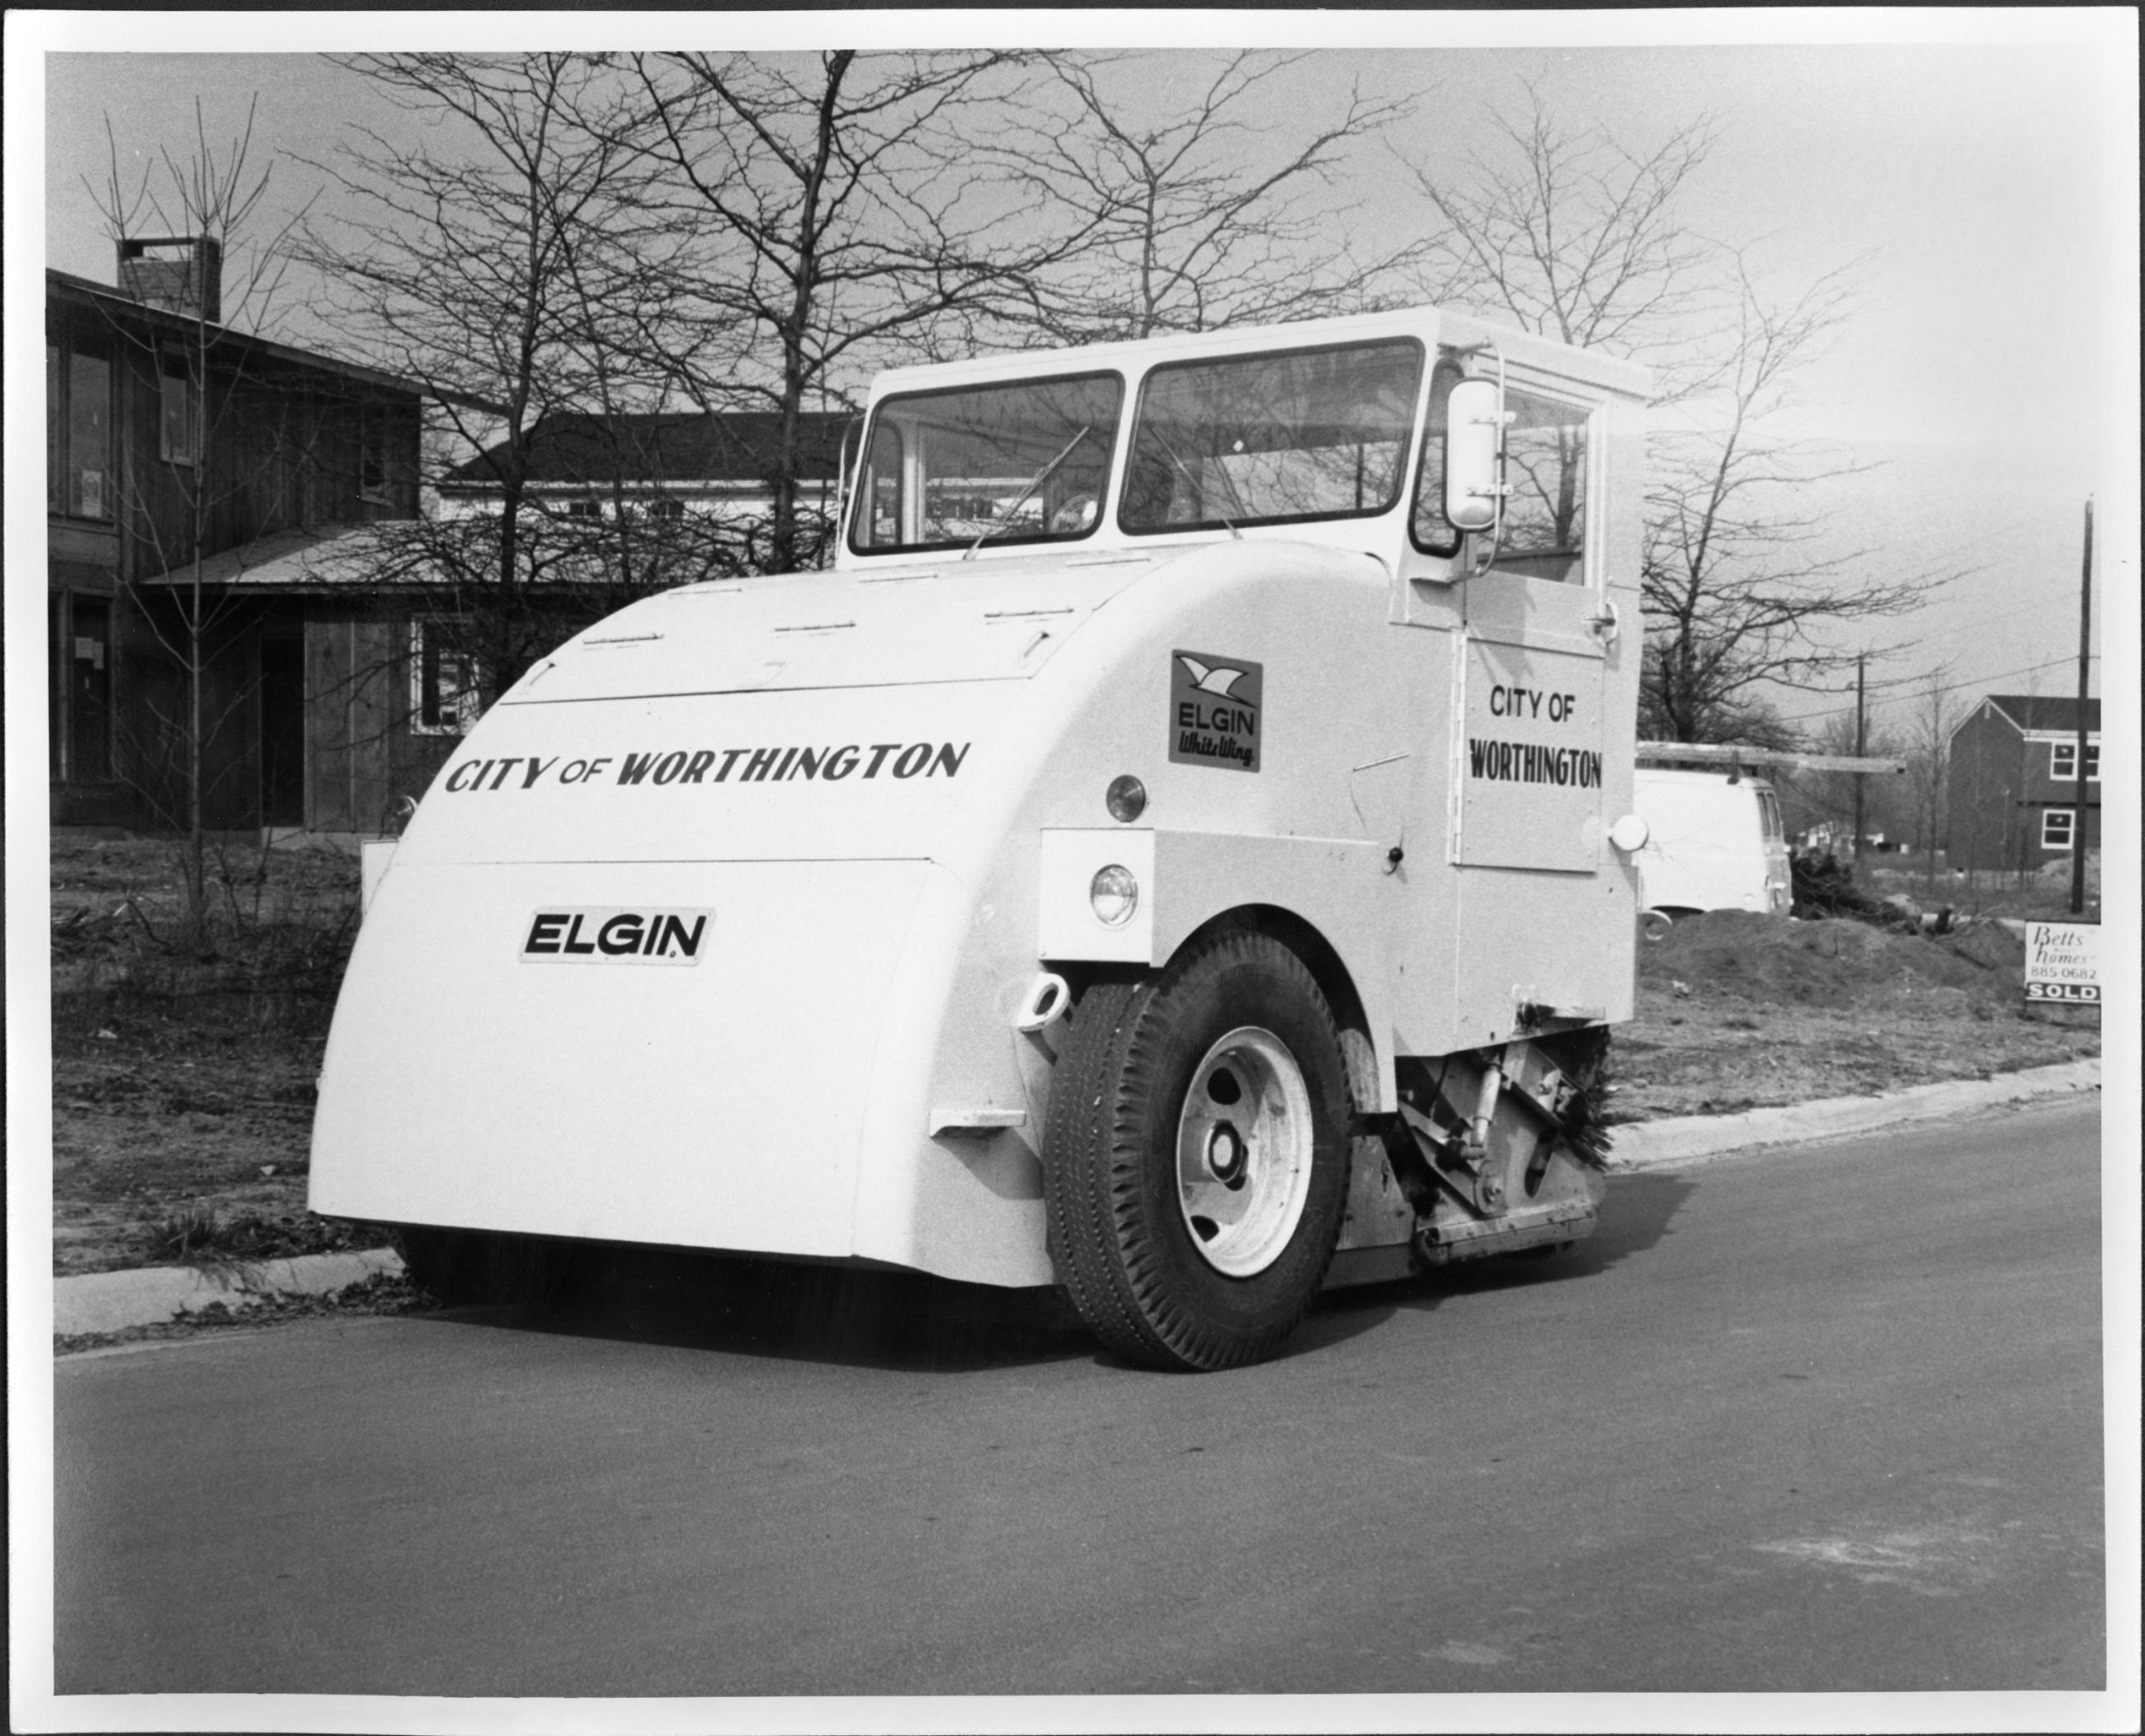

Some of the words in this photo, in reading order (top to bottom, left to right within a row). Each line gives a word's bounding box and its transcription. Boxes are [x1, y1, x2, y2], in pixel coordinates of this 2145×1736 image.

[1178, 702, 1255, 737] ELGIN
[1490, 684, 1543, 719] CITY
[1549, 692, 1576, 723] OF
[445, 755, 560, 793] CITY
[559, 757, 613, 785] OF
[615, 742, 972, 785] WORTHINGTON
[1469, 738, 1602, 789] WORTHINGTON
[524, 913, 707, 957] ELGIN
[2033, 926, 2084, 946] Betts
[2029, 984, 2097, 1000] SOLD
